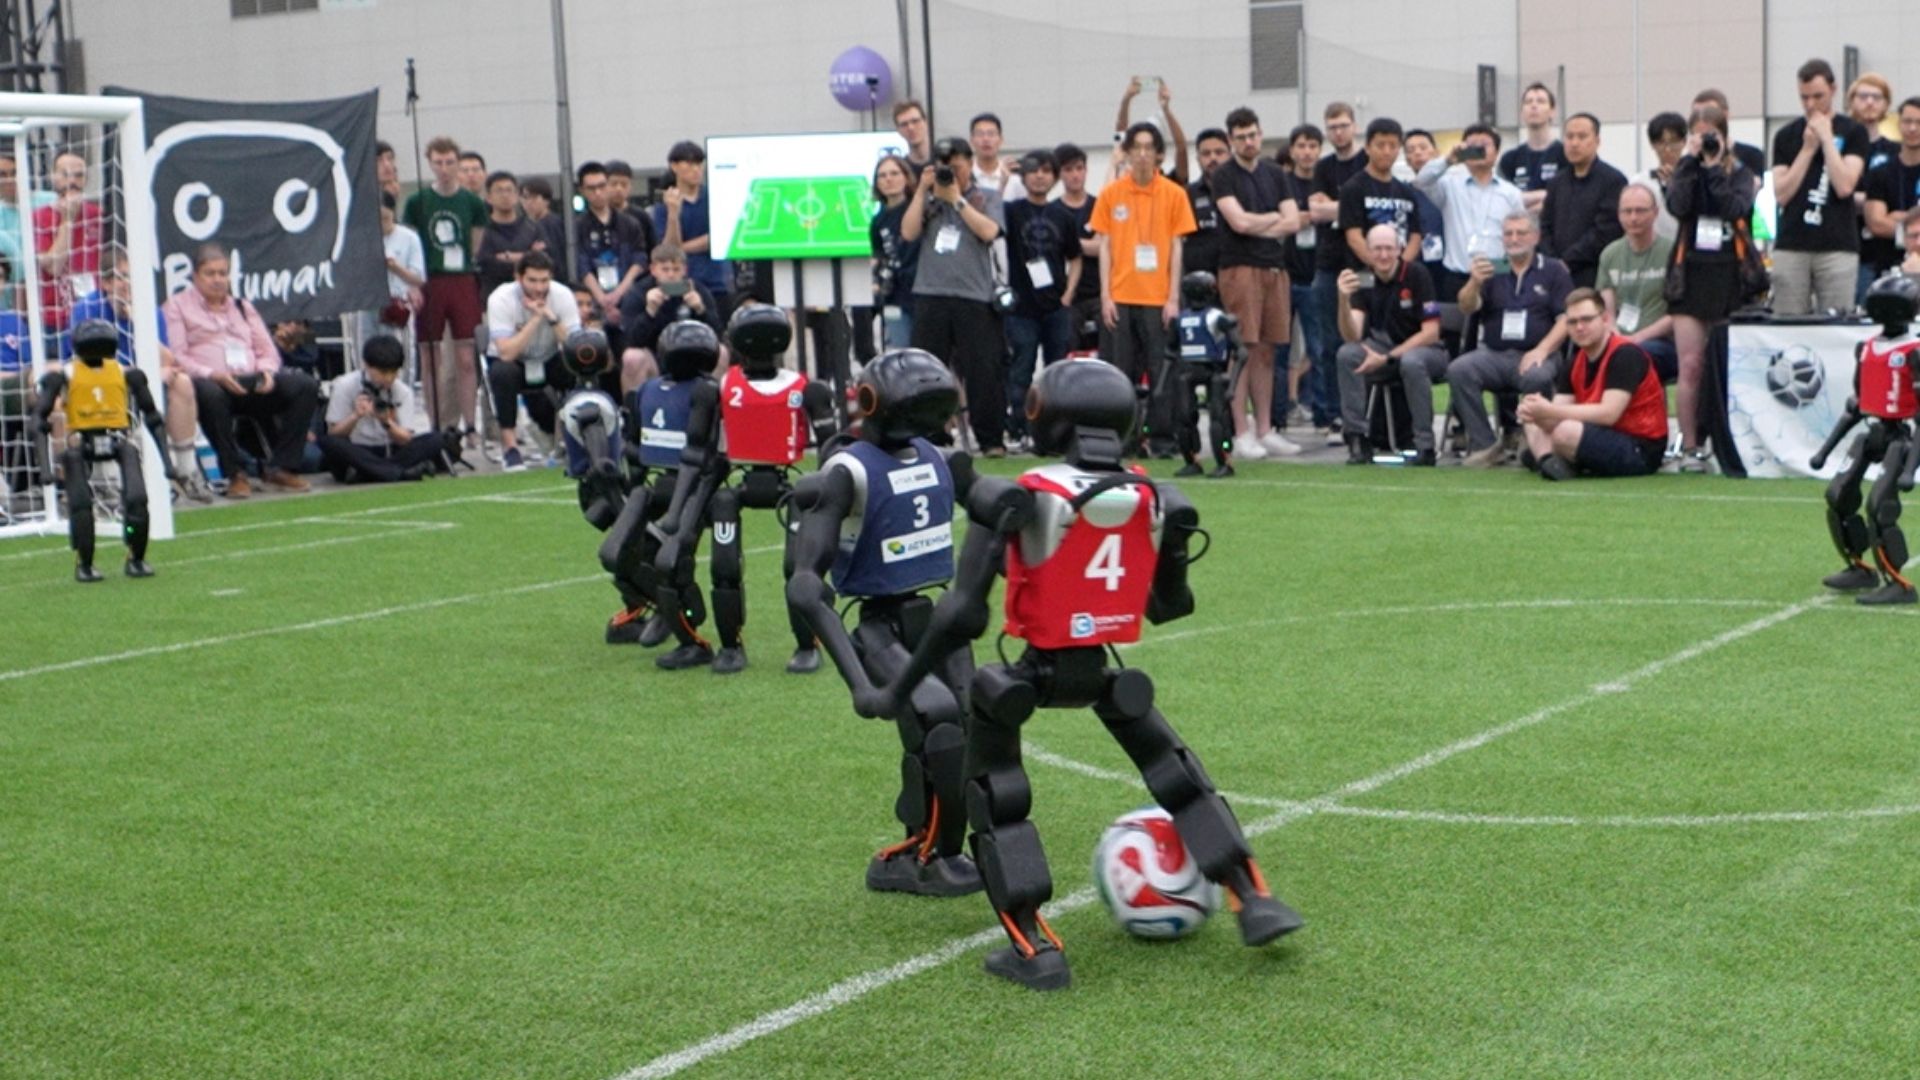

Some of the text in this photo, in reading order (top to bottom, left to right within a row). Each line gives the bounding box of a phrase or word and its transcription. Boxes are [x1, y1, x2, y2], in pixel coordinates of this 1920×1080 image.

[1803, 164, 1829, 226] B-Hum
[163, 248, 334, 304] Buman
[91, 386, 102, 403] 1
[729, 387, 744, 407] 2
[652, 408, 666, 429] 4
[913, 494, 930, 529] 3
[1085, 534, 1126, 591] 4
